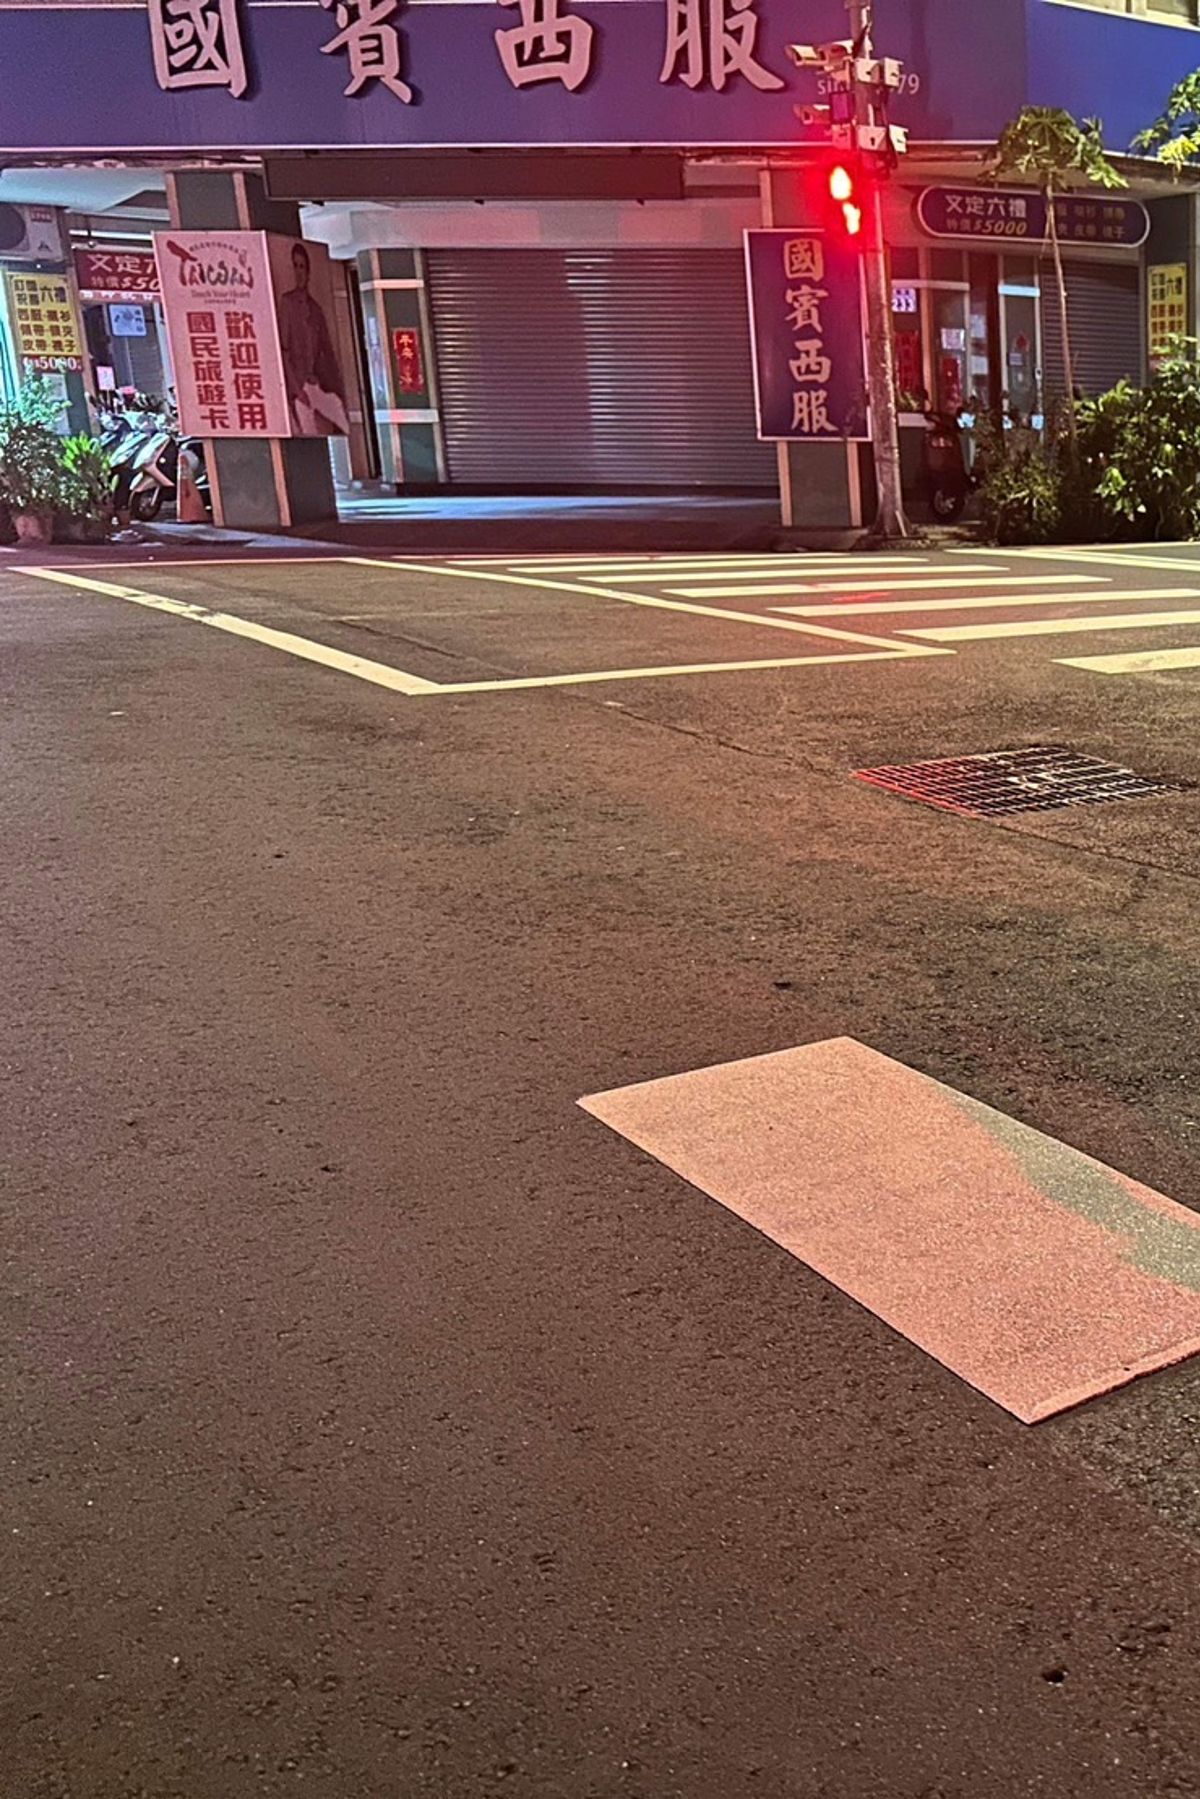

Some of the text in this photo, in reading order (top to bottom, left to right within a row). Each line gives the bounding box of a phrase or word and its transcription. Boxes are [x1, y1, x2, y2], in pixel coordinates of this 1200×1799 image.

[152, 0, 785, 104] 國賓西服
[945, 194, 1027, 219] 文定六禮
[186, 311, 231, 431] 國民旅遊卡
[224, 311, 268, 431] 歡迎使用
[783, 238, 839, 434] 國賓西服
